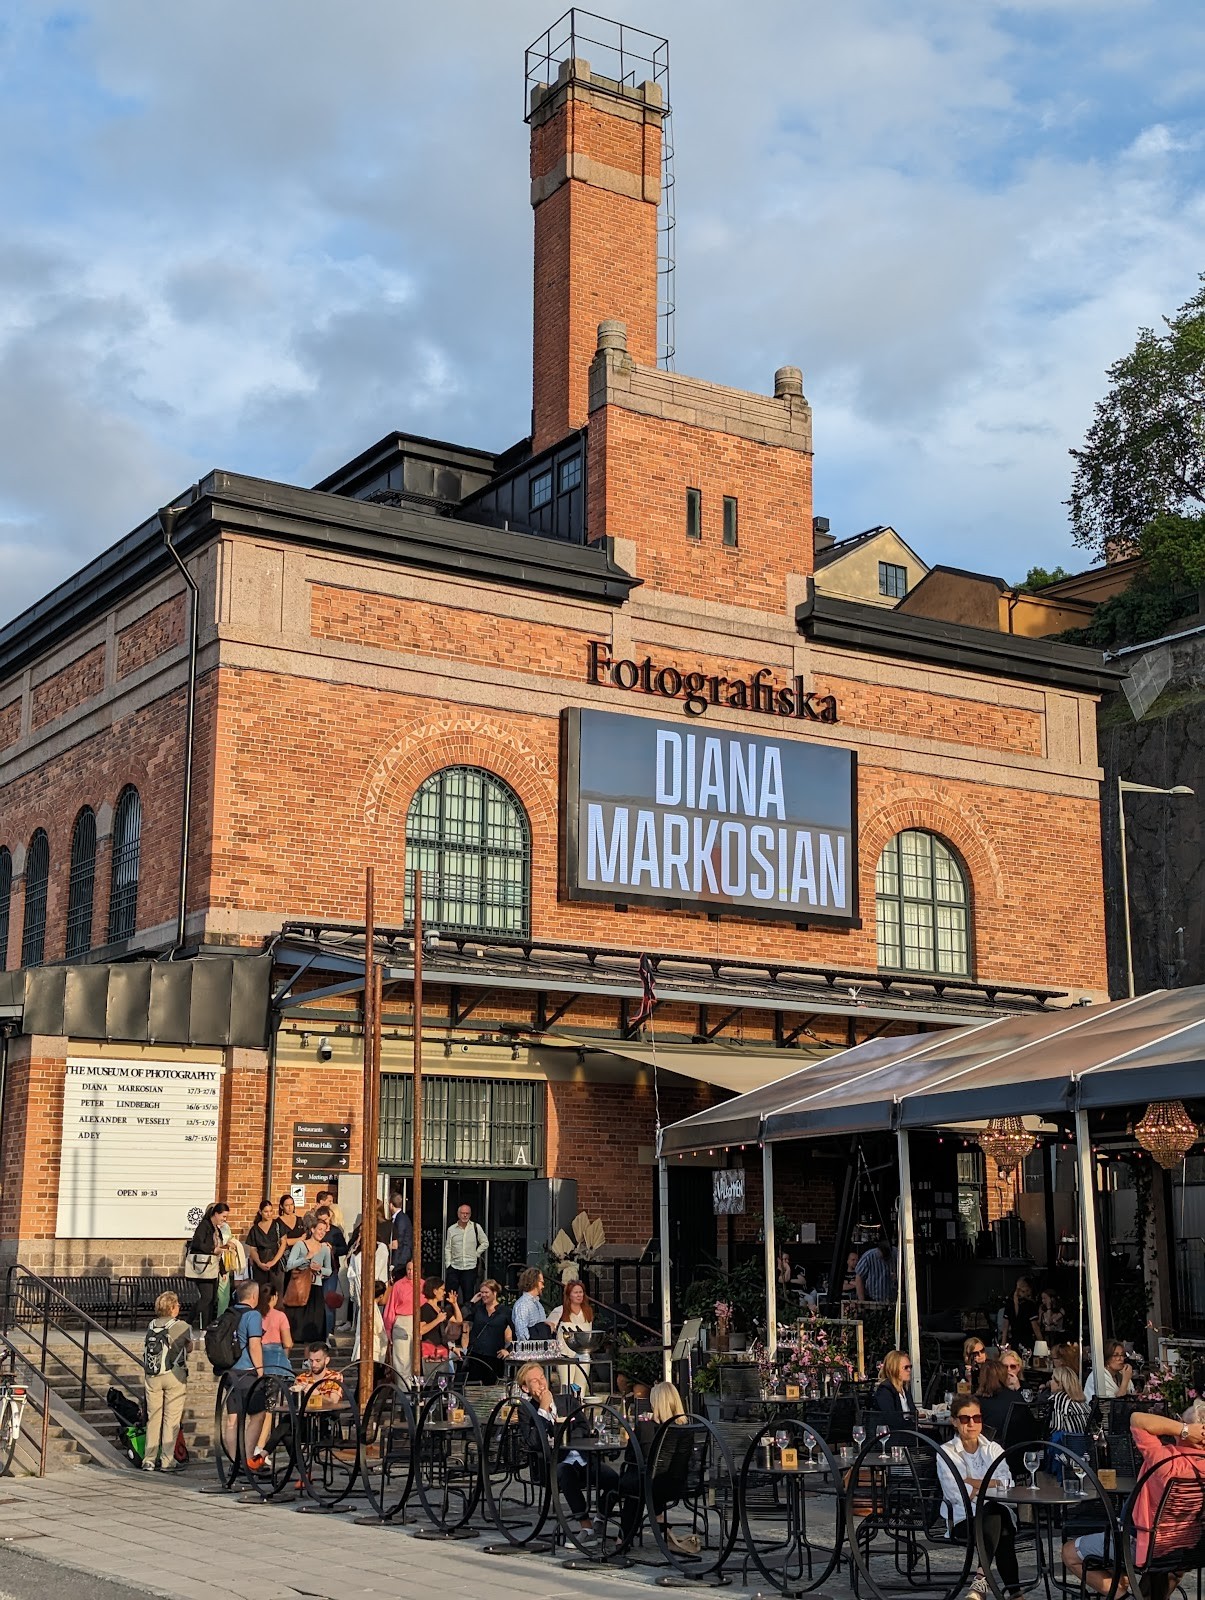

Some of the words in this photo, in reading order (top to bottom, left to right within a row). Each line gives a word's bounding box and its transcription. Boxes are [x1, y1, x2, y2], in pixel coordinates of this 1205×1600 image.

[587, 640, 840, 724] Fotografiska
[655, 729, 786, 821] DIANA
[587, 803, 846, 909] MARKOSIAN
[66, 1065, 85, 1075] THE
[87, 1066, 129, 1077] MUSEUM
[131, 1068, 144, 1077] OF
[145, 1069, 217, 1080] PHOTOGRAPHY
[82, 1083, 107, 1091] DIANA
[117, 1085, 163, 1093] MARKOSIAN
[187, 1087, 216, 1095] 17/3-27/8
[80, 1099, 104, 1107] PETER
[116, 1100, 160, 1109] LINDBERGH
[78, 1115, 127, 1124] ALEXANDER
[136, 1117, 170, 1125] WESSELY
[297, 1125, 323, 1133] Restaurants
[78, 1131, 100, 1139] ADEY
[296, 1141, 320, 1149] Exhibition
[514, 1145, 528, 1166] A
[295, 1157, 308, 1165] Shop
[308, 1173, 329, 1182] Meetings
[117, 1189, 138, 1197] OPEN
